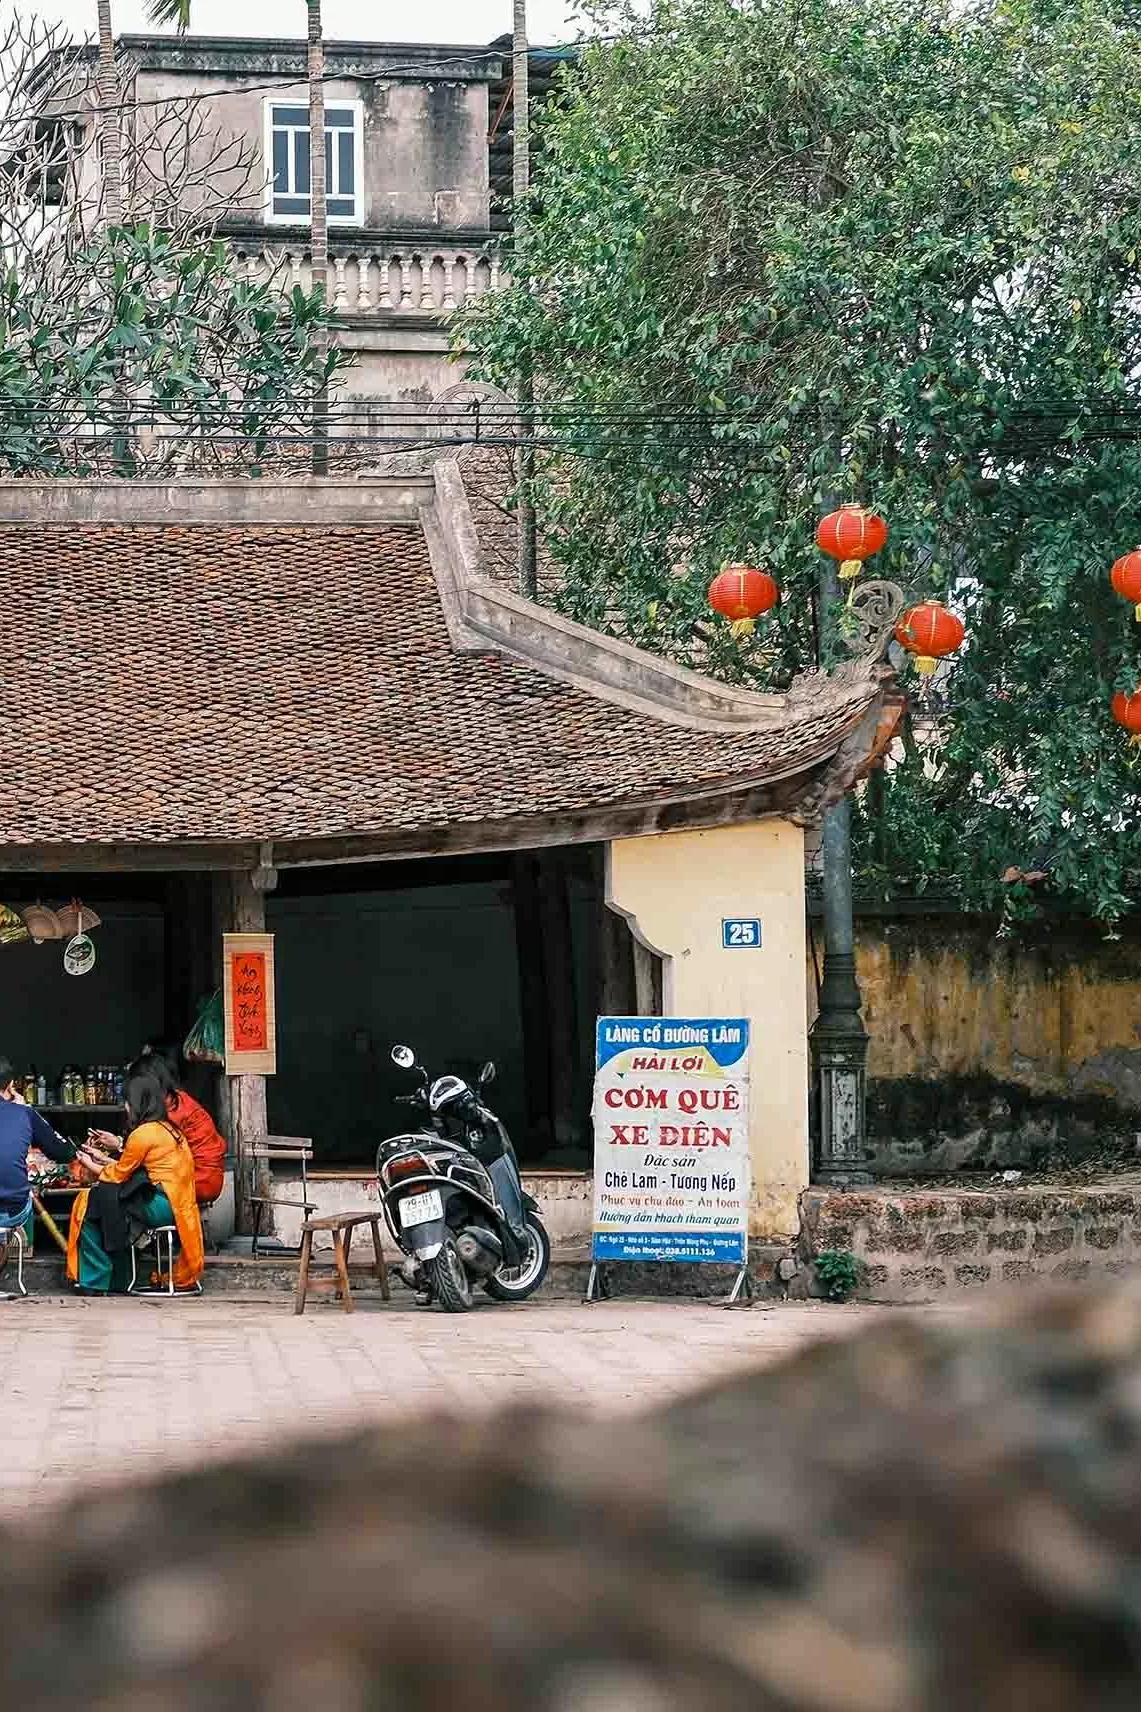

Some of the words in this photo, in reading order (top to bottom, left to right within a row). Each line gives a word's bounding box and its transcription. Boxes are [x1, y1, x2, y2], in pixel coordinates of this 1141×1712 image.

[730, 924, 754, 944] 25
[605, 1026, 639, 1043] LÀNG
[643, 1023, 661, 1043] CỔ
[663, 1026, 708, 1044] ĐƯỜNG
[712, 1026, 740, 1044] LÂM
[671, 1056, 705, 1075] LỢI
[604, 1084, 668, 1110] CƠM
[678, 1084, 740, 1114] QUÊ
[609, 1125, 650, 1147] XE
[659, 1121, 733, 1152] ĐIỆN
[632, 1172, 657, 1188] Lam
[712, 1169, 736, 1192] Nếp
[714, 1216, 740, 1226] quan
